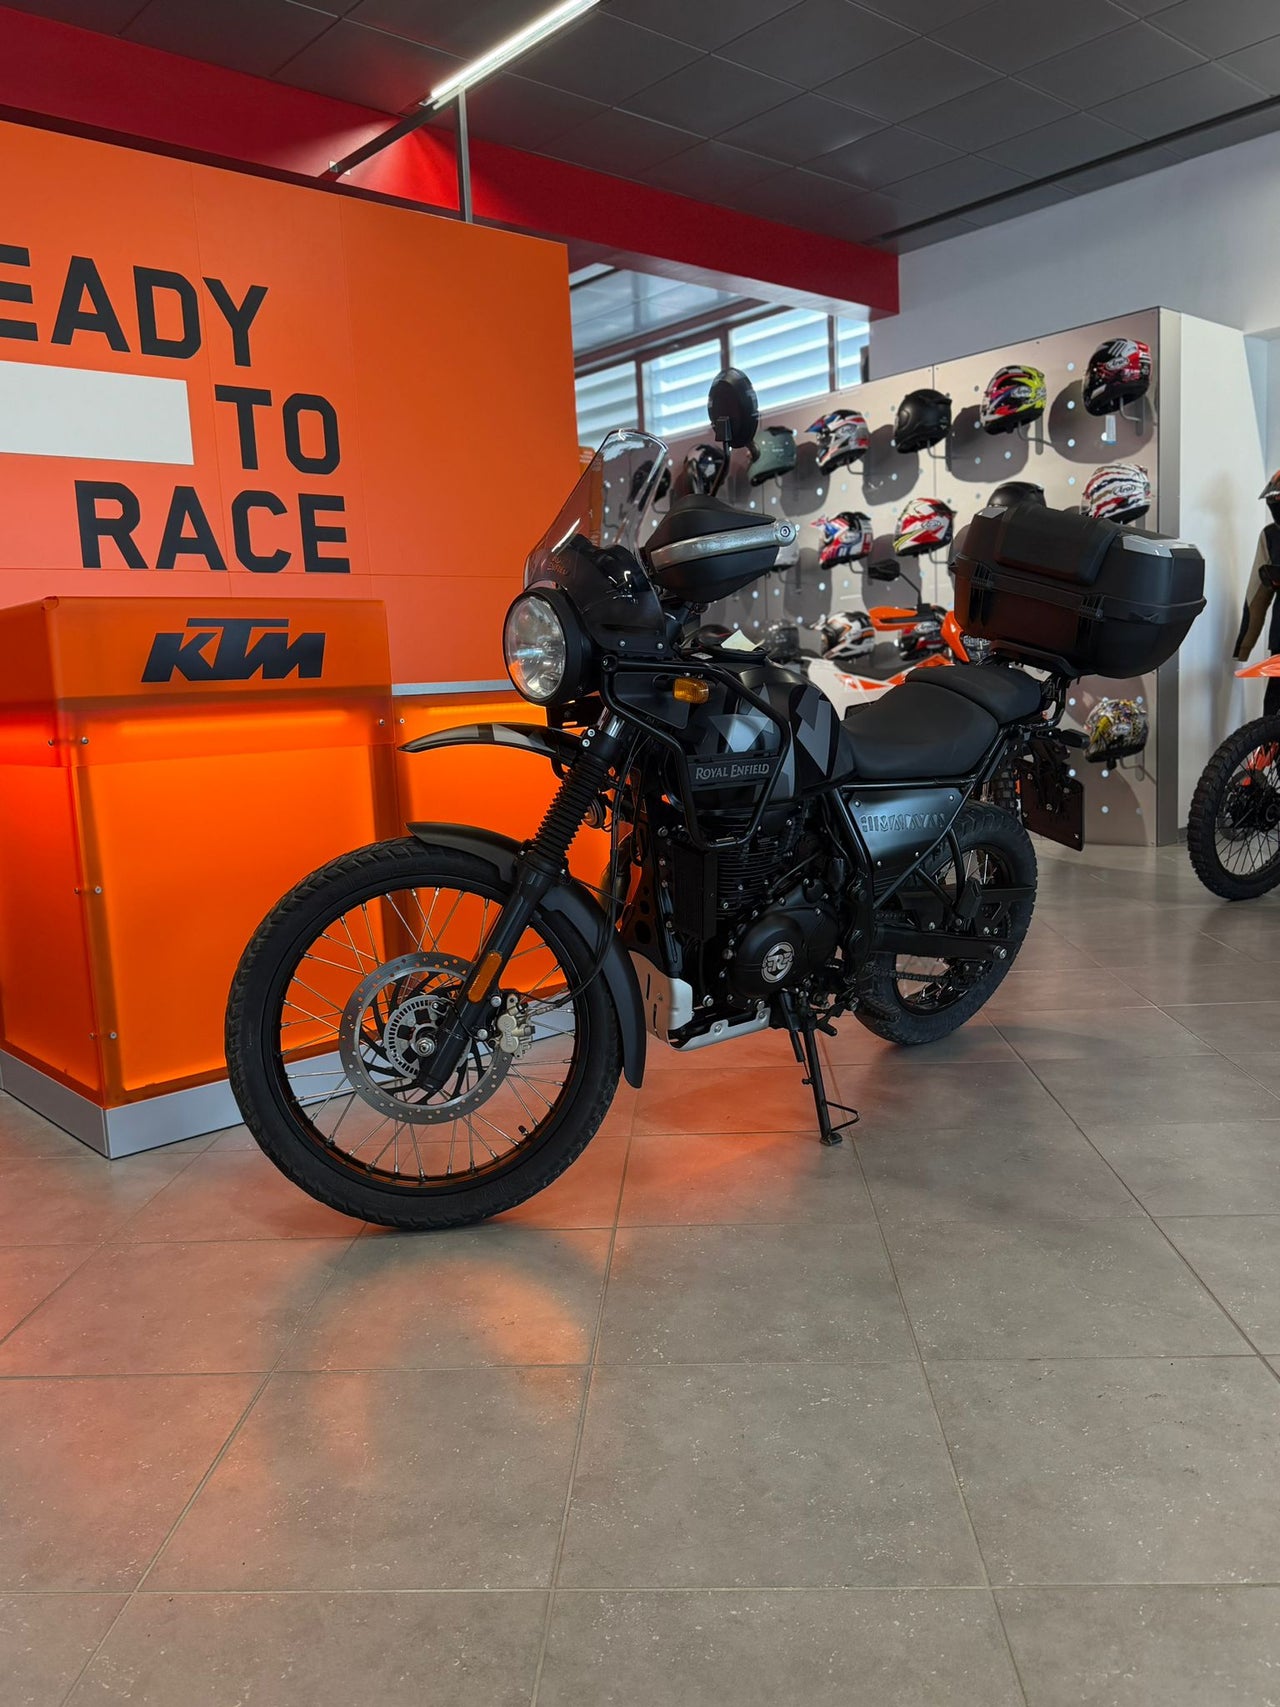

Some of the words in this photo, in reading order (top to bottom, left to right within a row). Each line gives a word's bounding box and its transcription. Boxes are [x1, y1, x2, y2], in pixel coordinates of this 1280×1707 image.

[215, 385, 340, 475] TO
[75, 480, 350, 573] RACE
[141, 618, 325, 682] KTM
